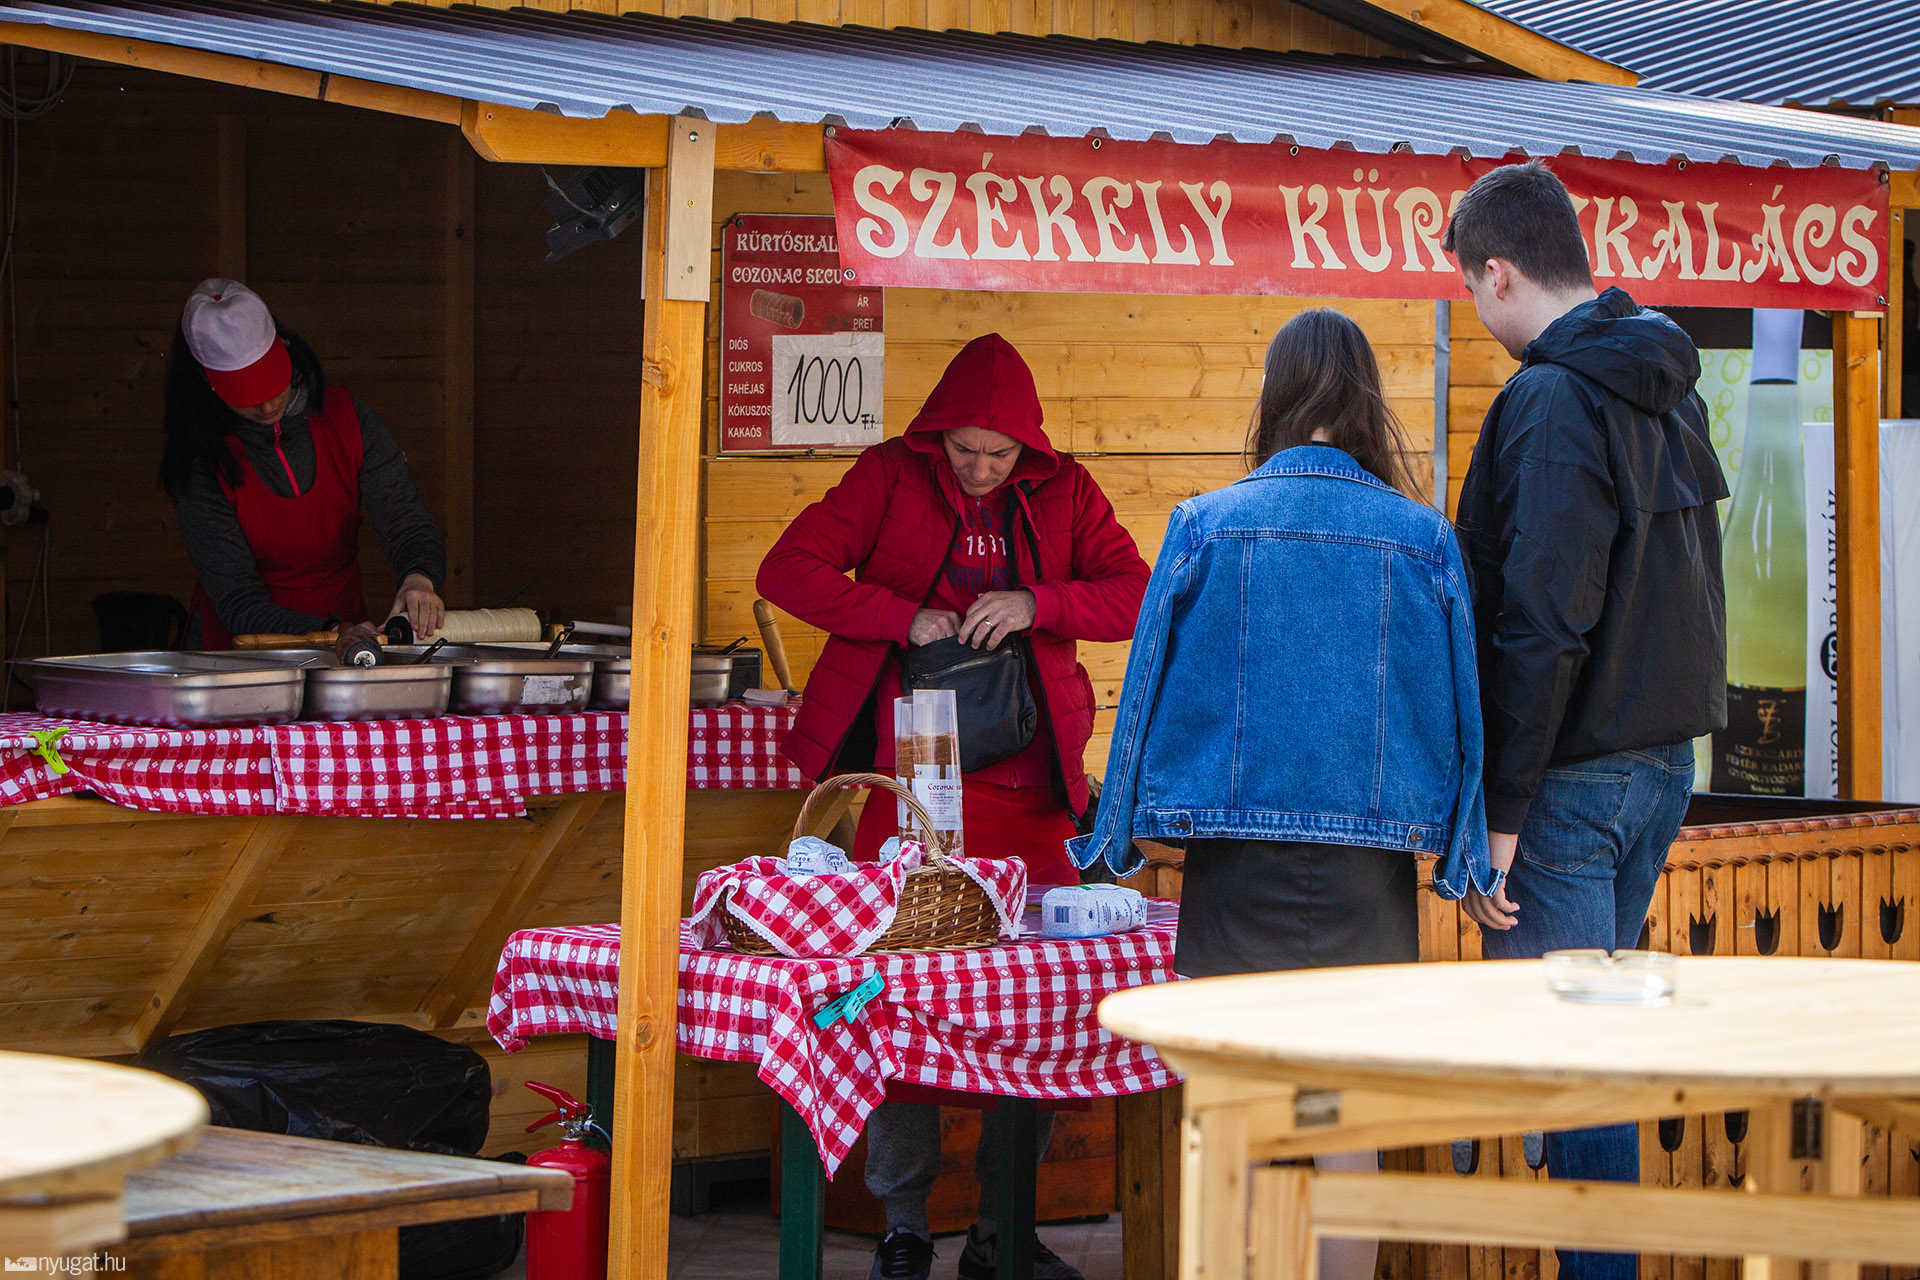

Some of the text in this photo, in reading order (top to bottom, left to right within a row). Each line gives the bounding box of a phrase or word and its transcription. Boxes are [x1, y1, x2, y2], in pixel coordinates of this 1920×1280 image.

[852, 151, 1879, 287] SZÉKELY KÜRKALÁCS
[736, 229, 840, 252] KÜRTŐSKAL
[732, 266, 842, 284] COZONAC SECU
[857, 294, 870, 308] ÁR
[728, 336, 749, 351] DIÓS
[728, 360, 764, 373] CUKROS
[728, 381, 766, 395] FAHÉJAS
[787, 353, 863, 424] 1000
[727, 425, 762, 438] KAKAÓS
